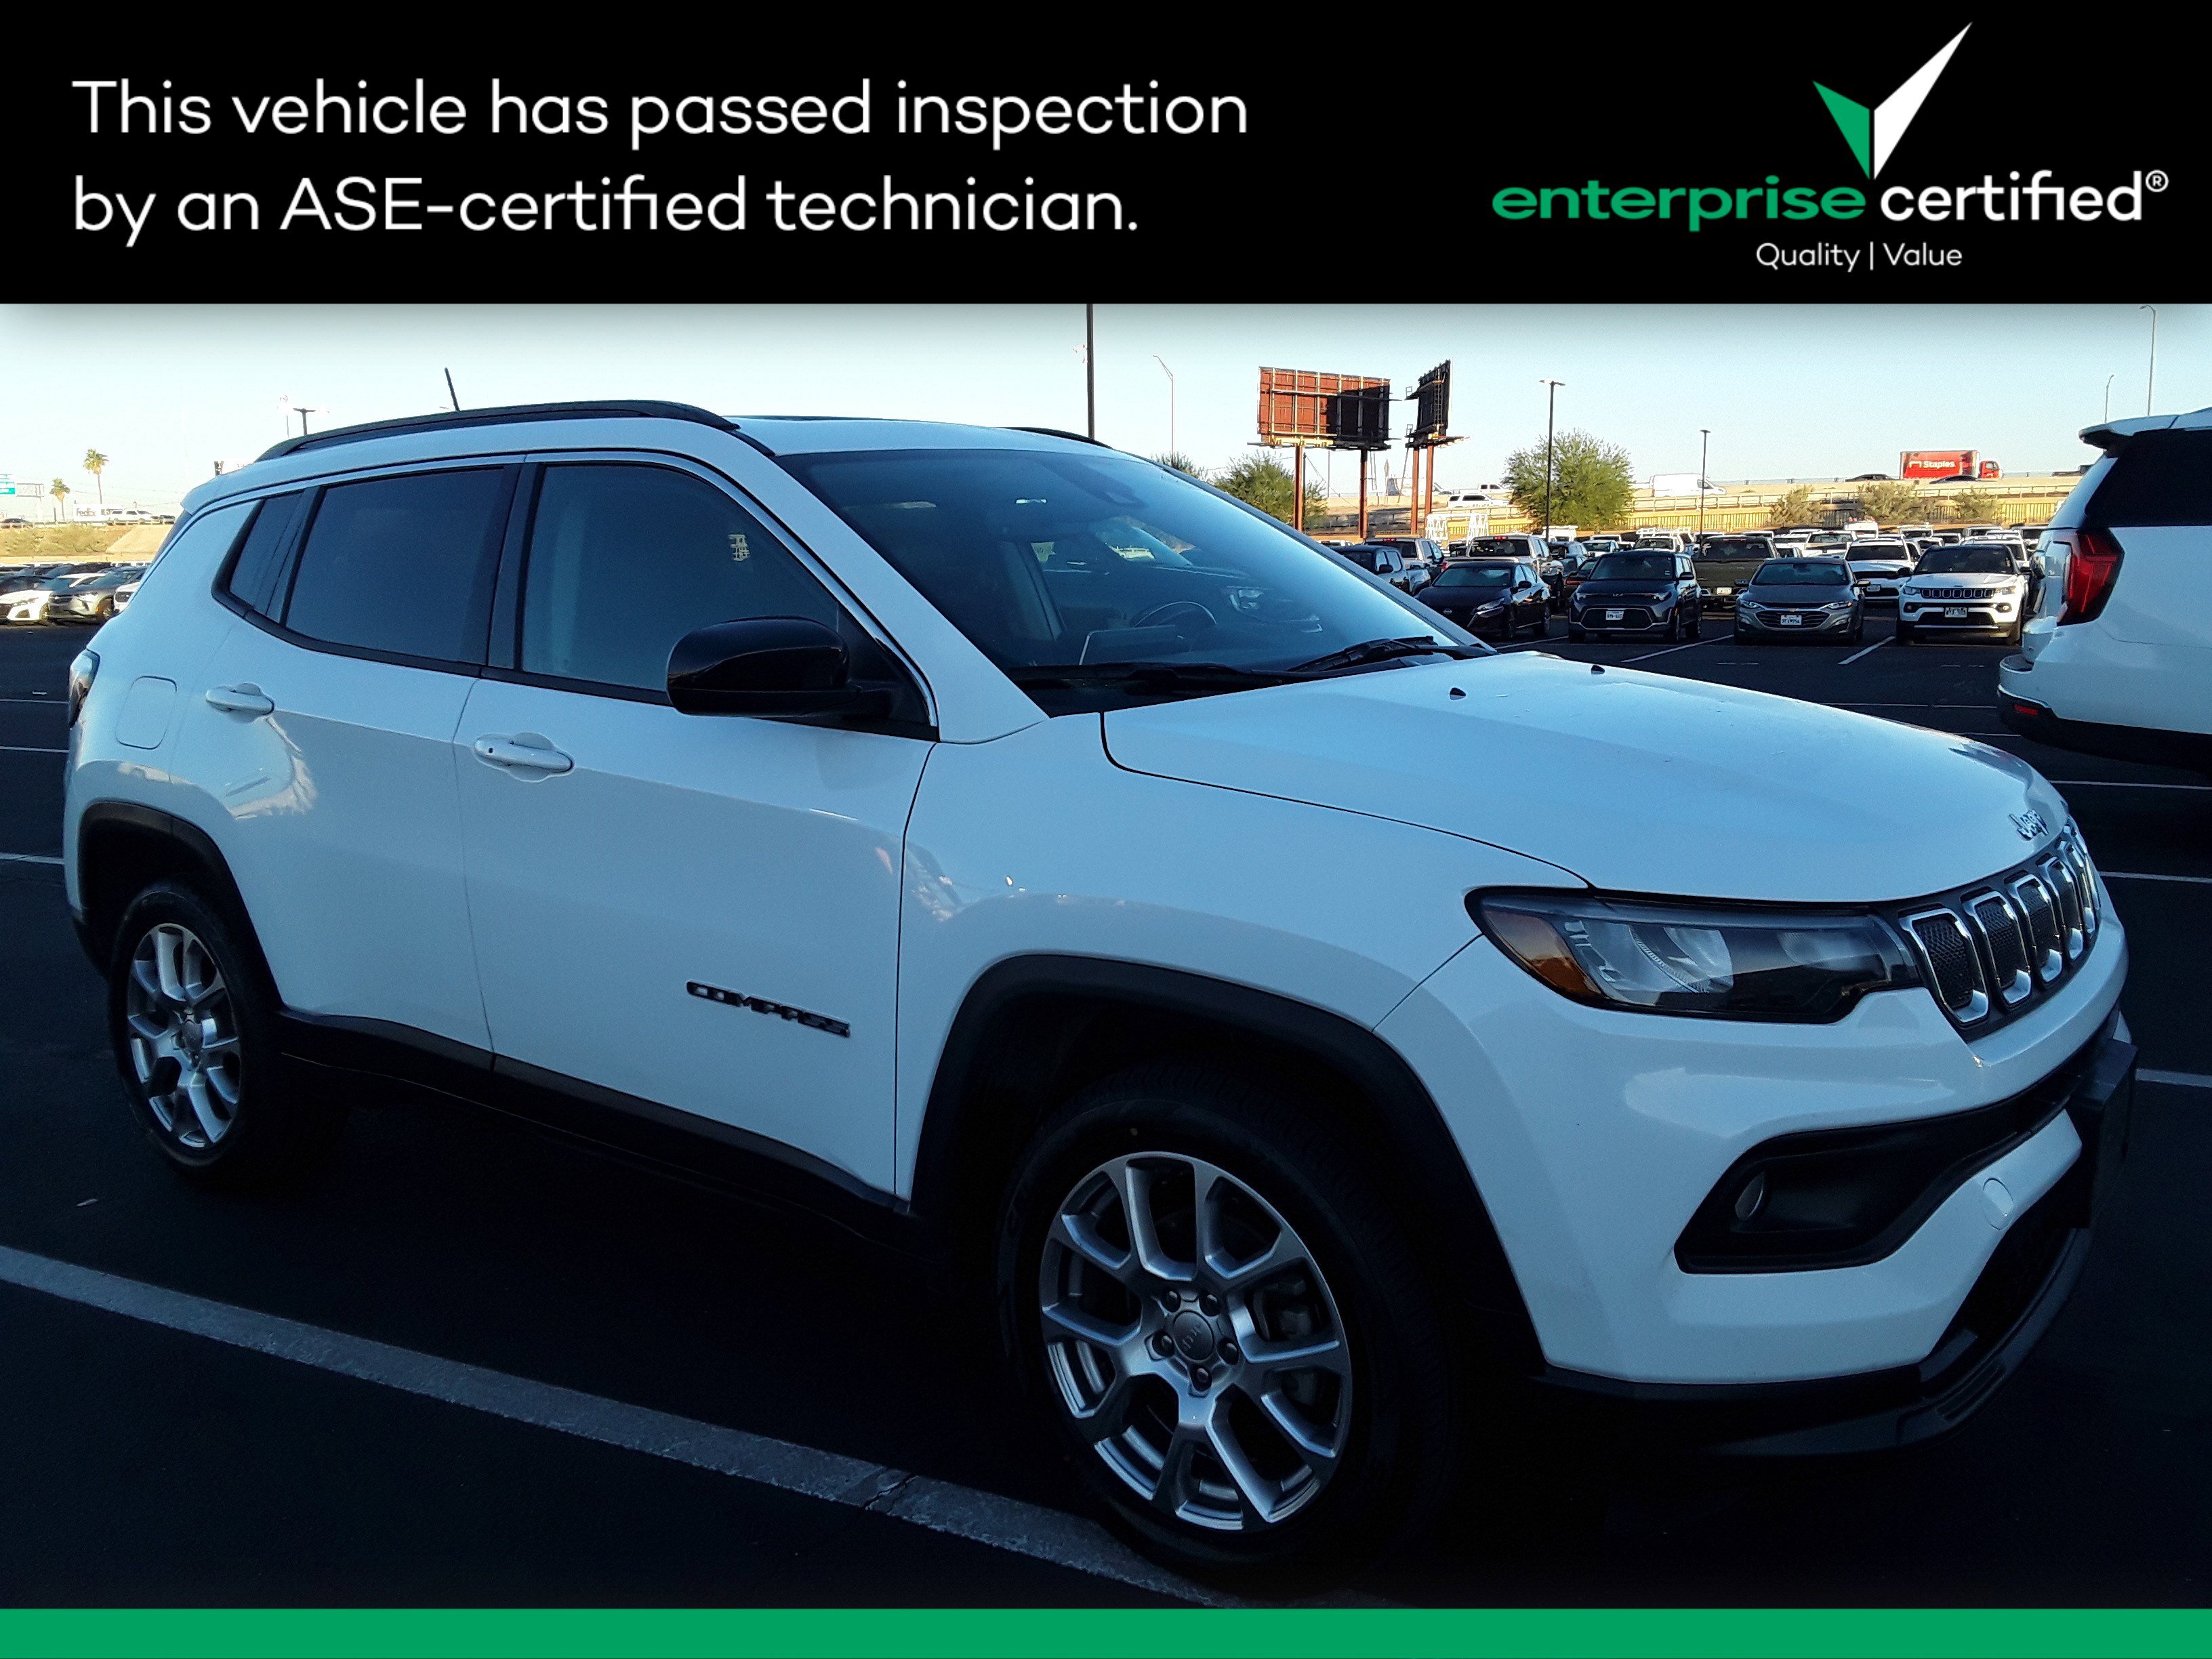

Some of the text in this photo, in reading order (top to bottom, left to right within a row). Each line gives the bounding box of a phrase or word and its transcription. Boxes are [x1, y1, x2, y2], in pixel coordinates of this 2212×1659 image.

[1923, 460, 1955, 469] Staples
[76, 508, 96, 517] FedEx
[2009, 808, 2049, 841] Jeep
[685, 980, 851, 1038] COMPASS
